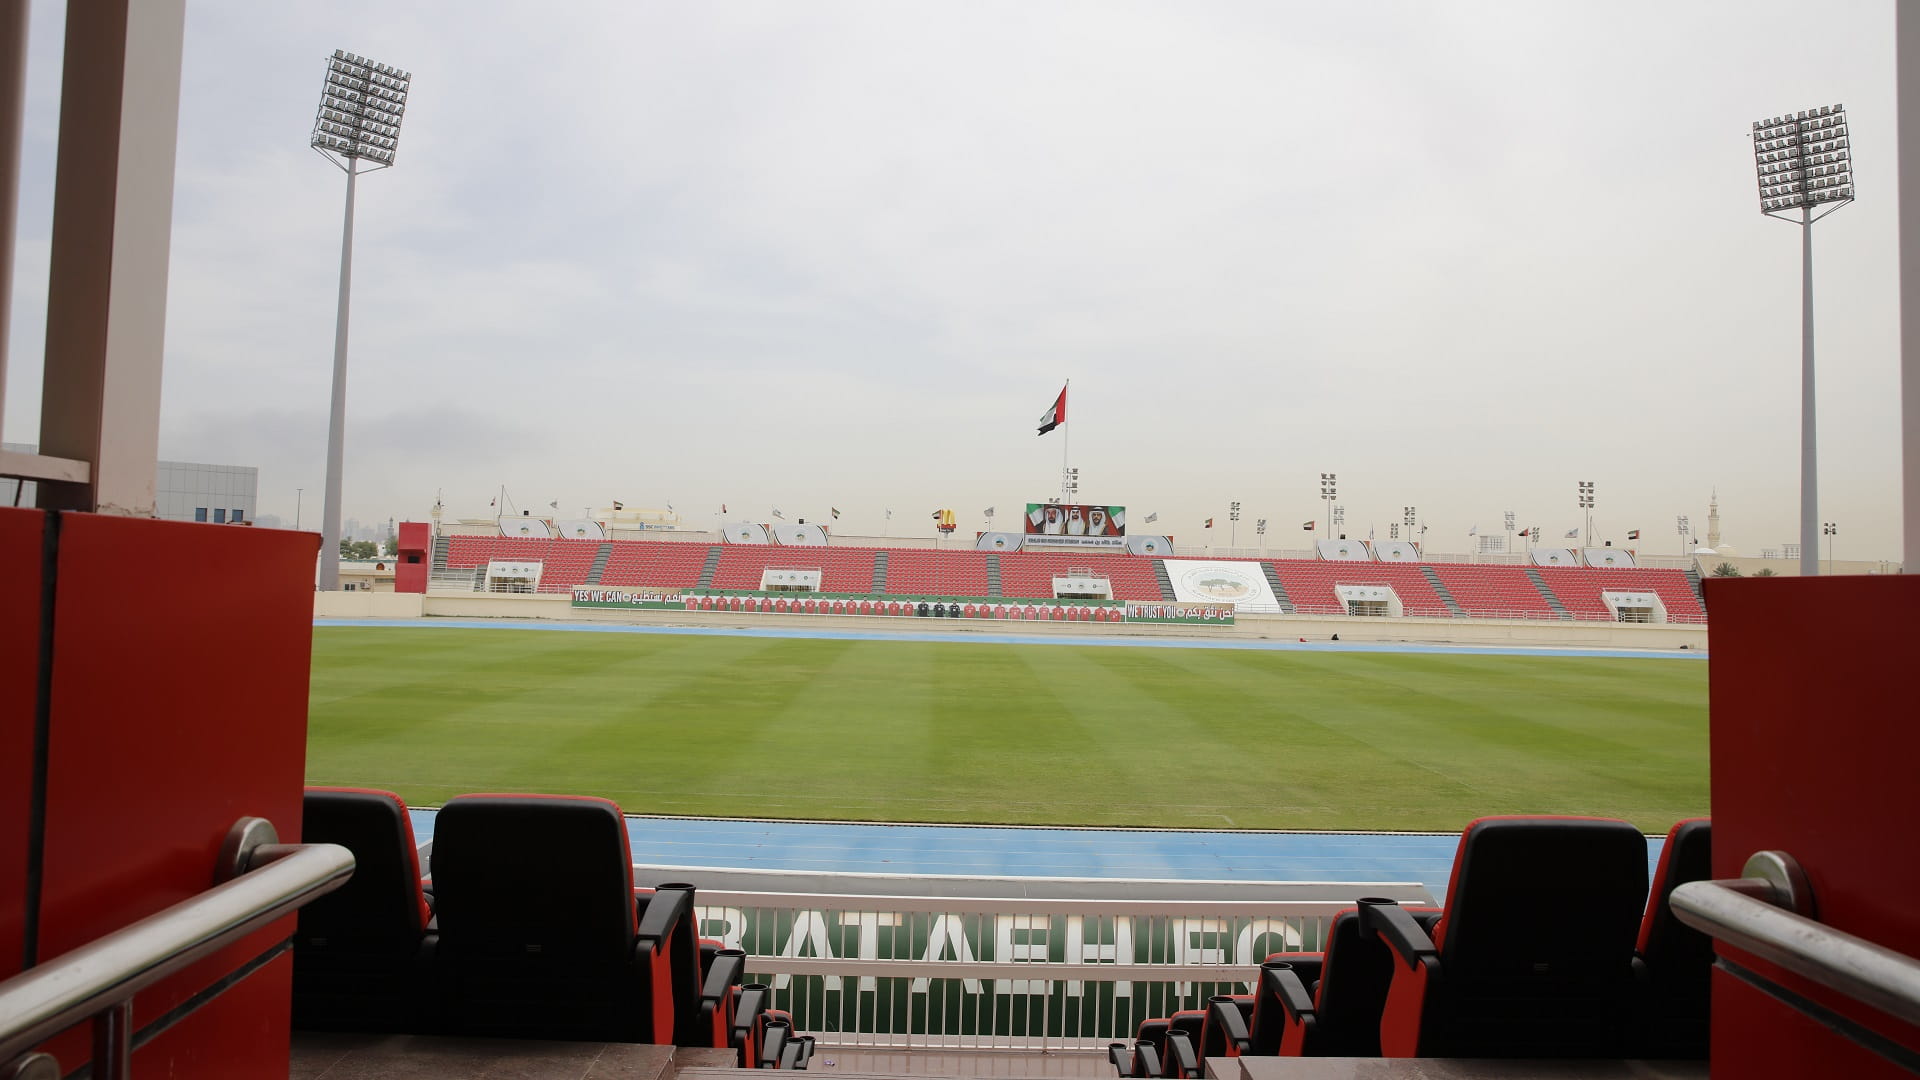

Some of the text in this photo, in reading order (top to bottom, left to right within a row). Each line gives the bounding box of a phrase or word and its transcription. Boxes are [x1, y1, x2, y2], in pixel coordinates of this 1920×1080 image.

[574, 590, 622, 603] YES WE CAN
[631, 590, 682, 605] نعم نستطيع
[1127, 604, 1139, 618] WE
[1140, 604, 1160, 619] TRUST
[1162, 605, 1176, 619] YOU
[1185, 604, 1234, 621] نحن نثق بكم
